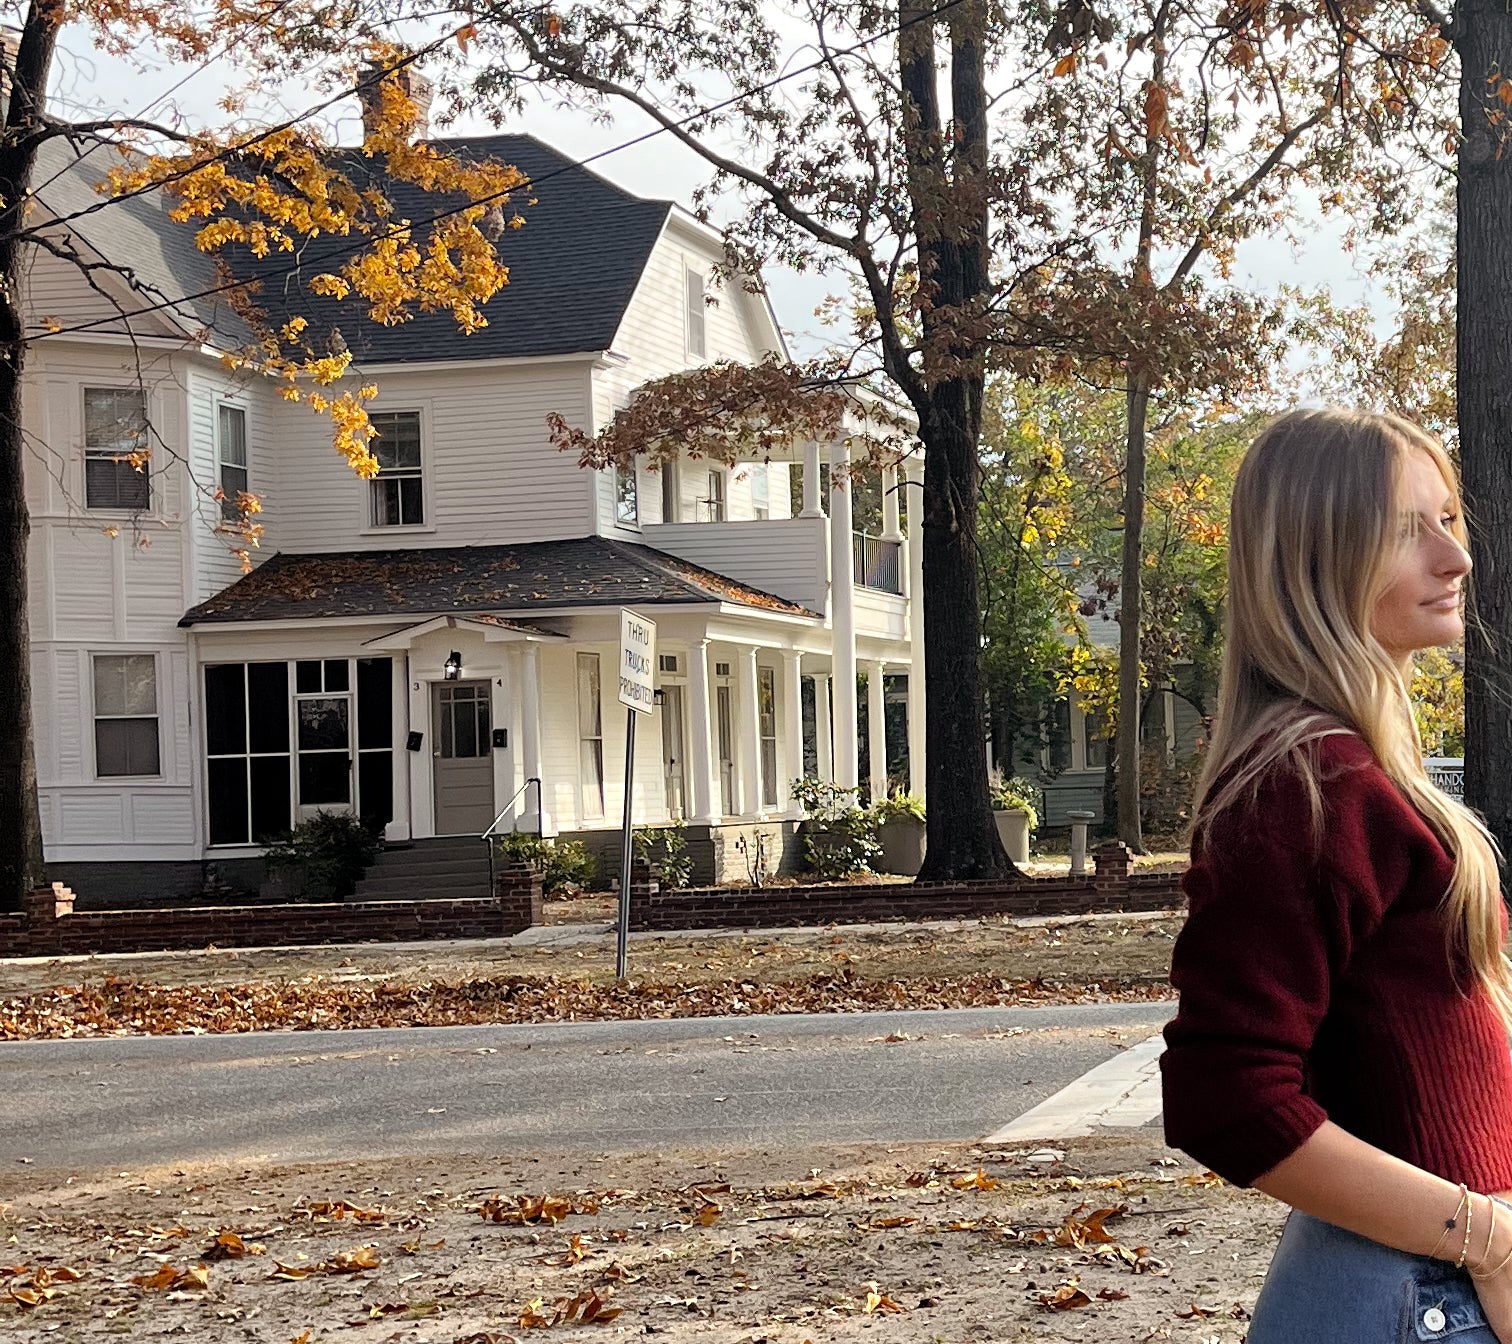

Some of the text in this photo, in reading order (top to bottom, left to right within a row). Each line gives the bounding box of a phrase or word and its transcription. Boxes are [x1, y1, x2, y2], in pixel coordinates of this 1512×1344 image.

[627, 620, 649, 646] THRU
[624, 648, 650, 676] TRUCKS
[413, 682, 420, 691] 3
